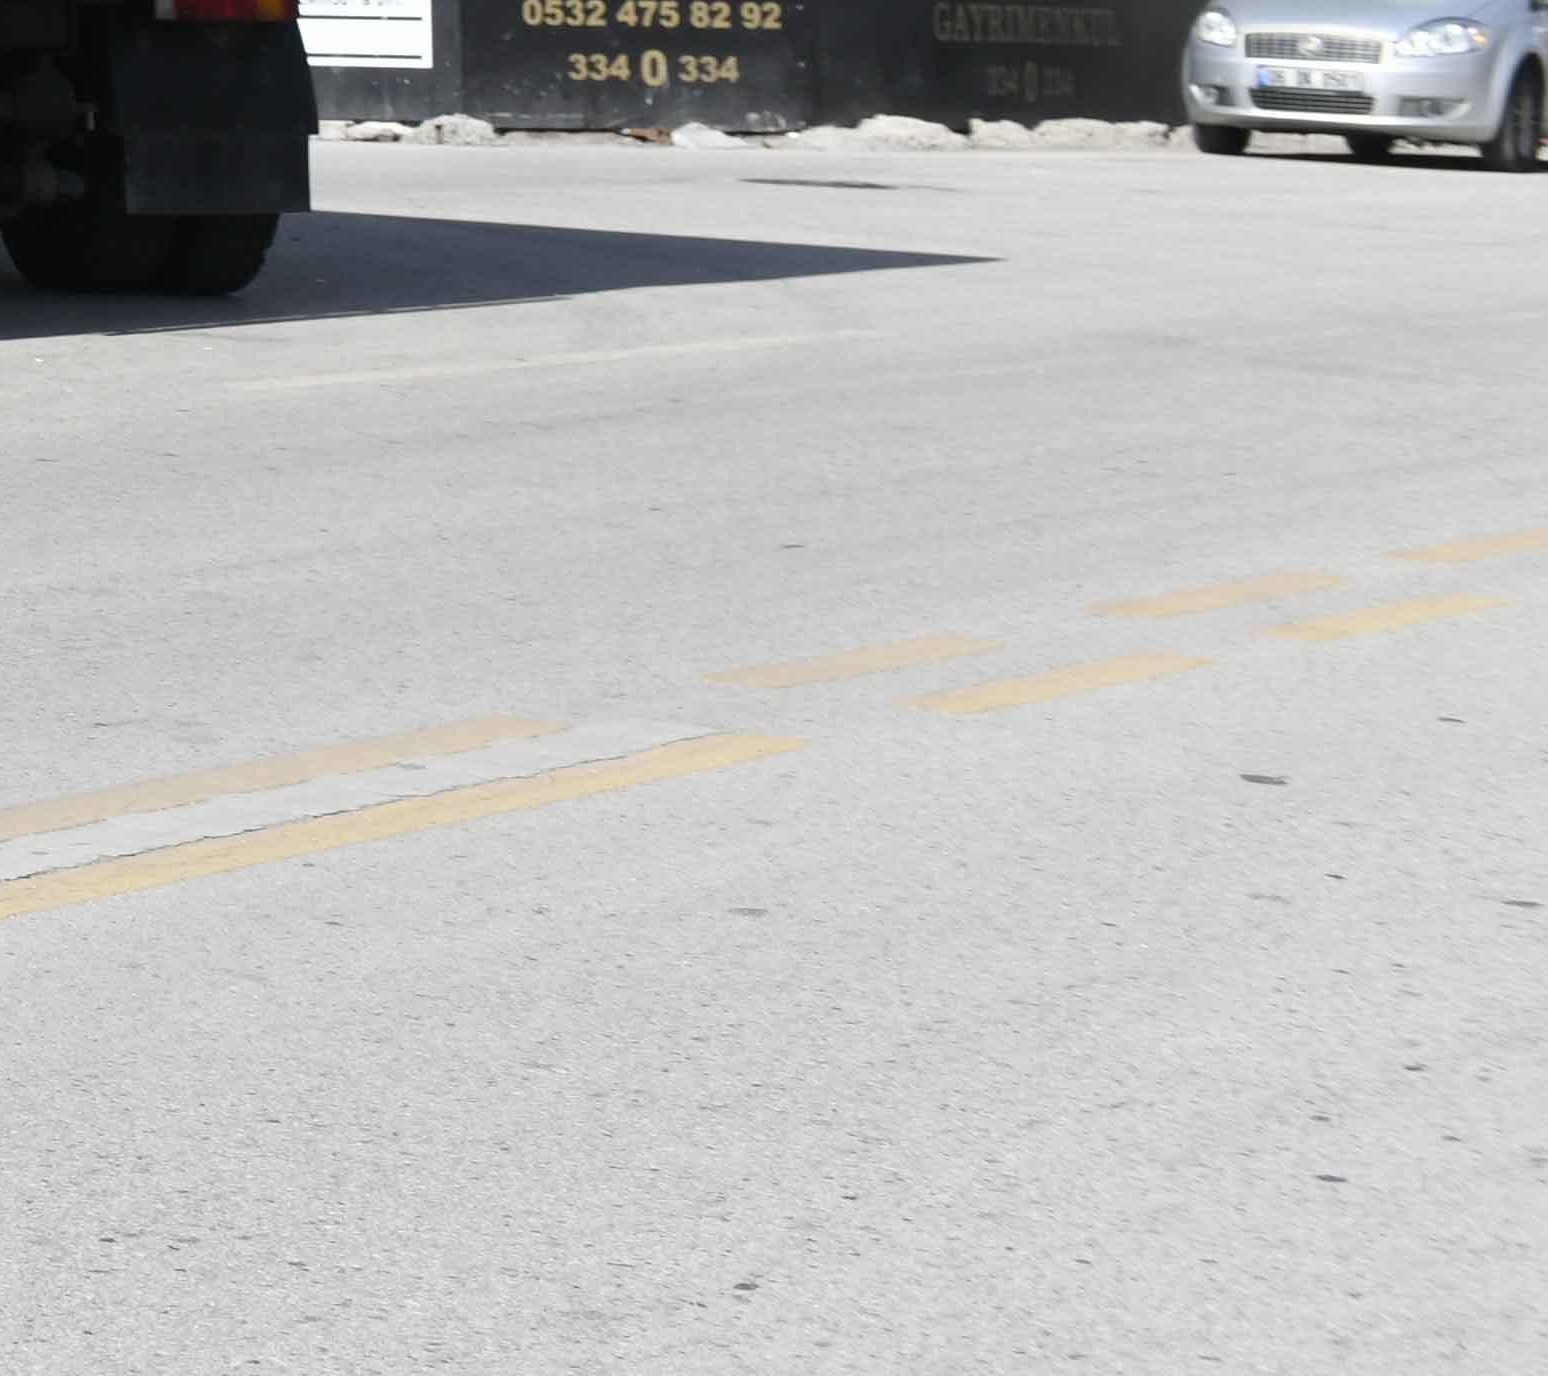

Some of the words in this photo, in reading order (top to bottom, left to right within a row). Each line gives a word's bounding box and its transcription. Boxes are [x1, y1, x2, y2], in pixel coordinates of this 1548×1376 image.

[616, 0, 680, 28] 475
[690, 1, 732, 29] 82
[740, 2, 782, 30] 92
[568, 53, 631, 81] 334
[640, 49, 668, 87] 0
[678, 55, 740, 83] 334
